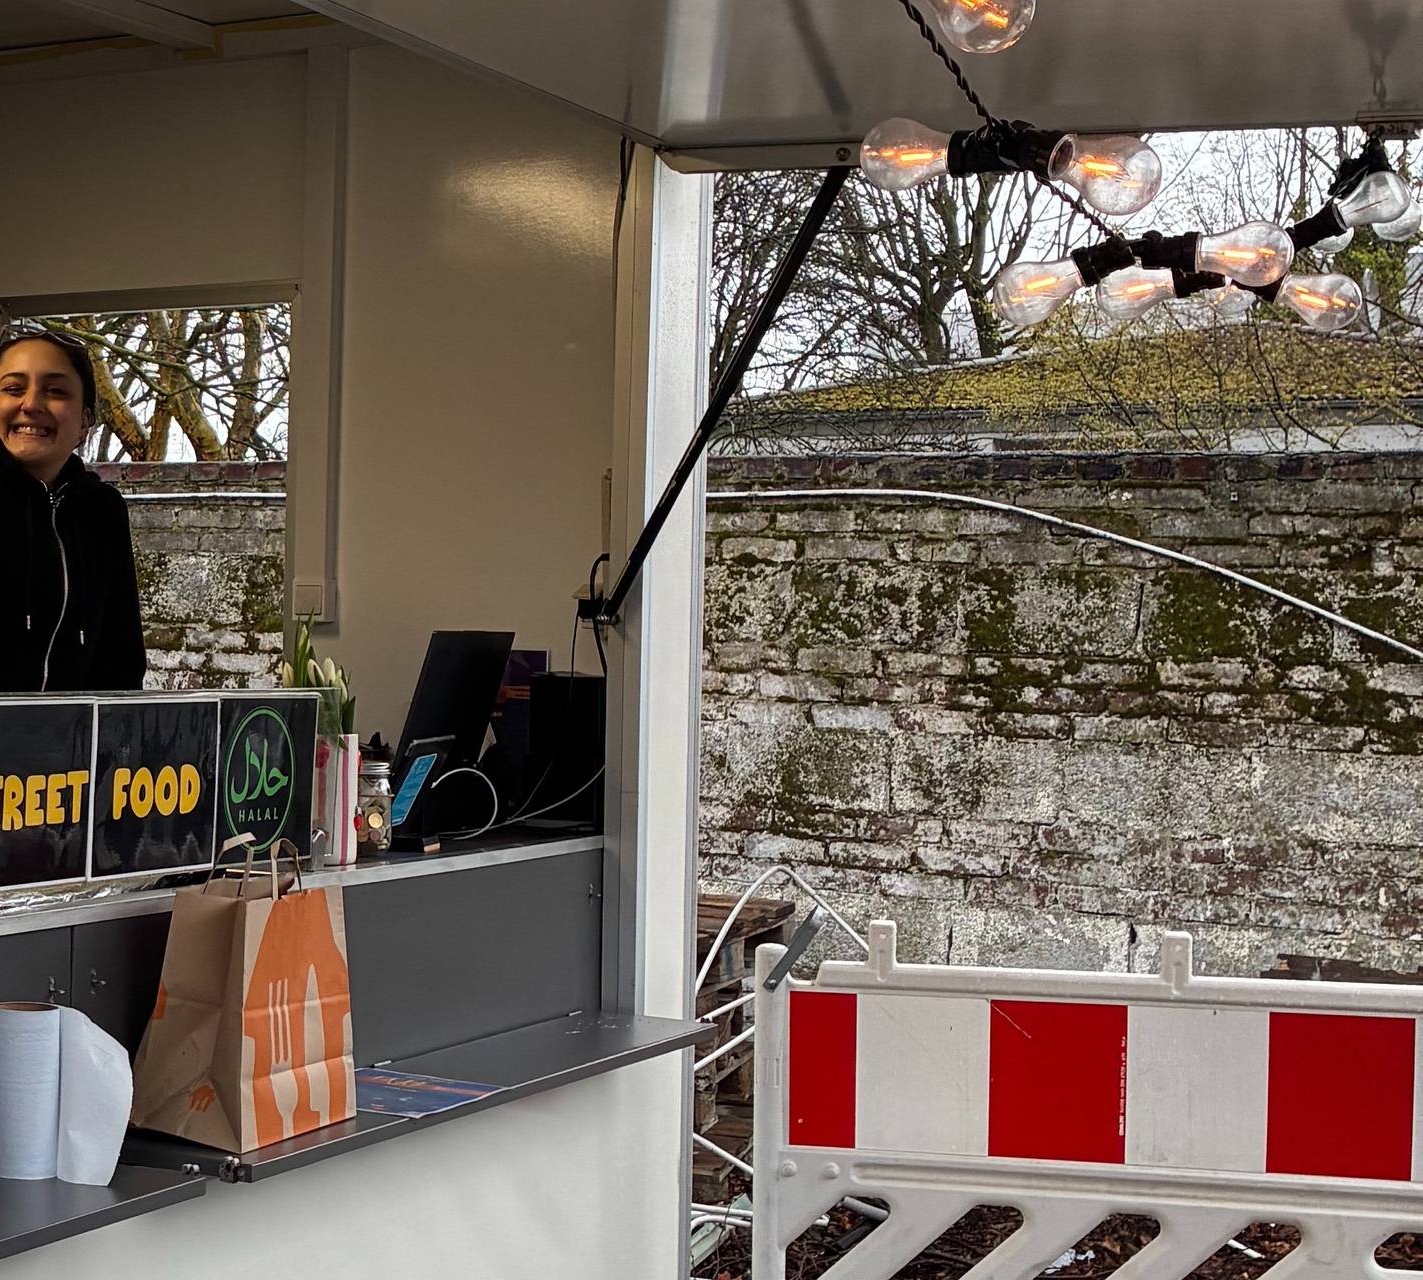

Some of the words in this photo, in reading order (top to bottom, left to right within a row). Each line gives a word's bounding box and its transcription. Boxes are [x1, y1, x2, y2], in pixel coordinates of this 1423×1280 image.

[111, 763, 202, 821] FOOD
[230, 736, 289, 804] حلال
[238, 807, 279, 823] HALAL
